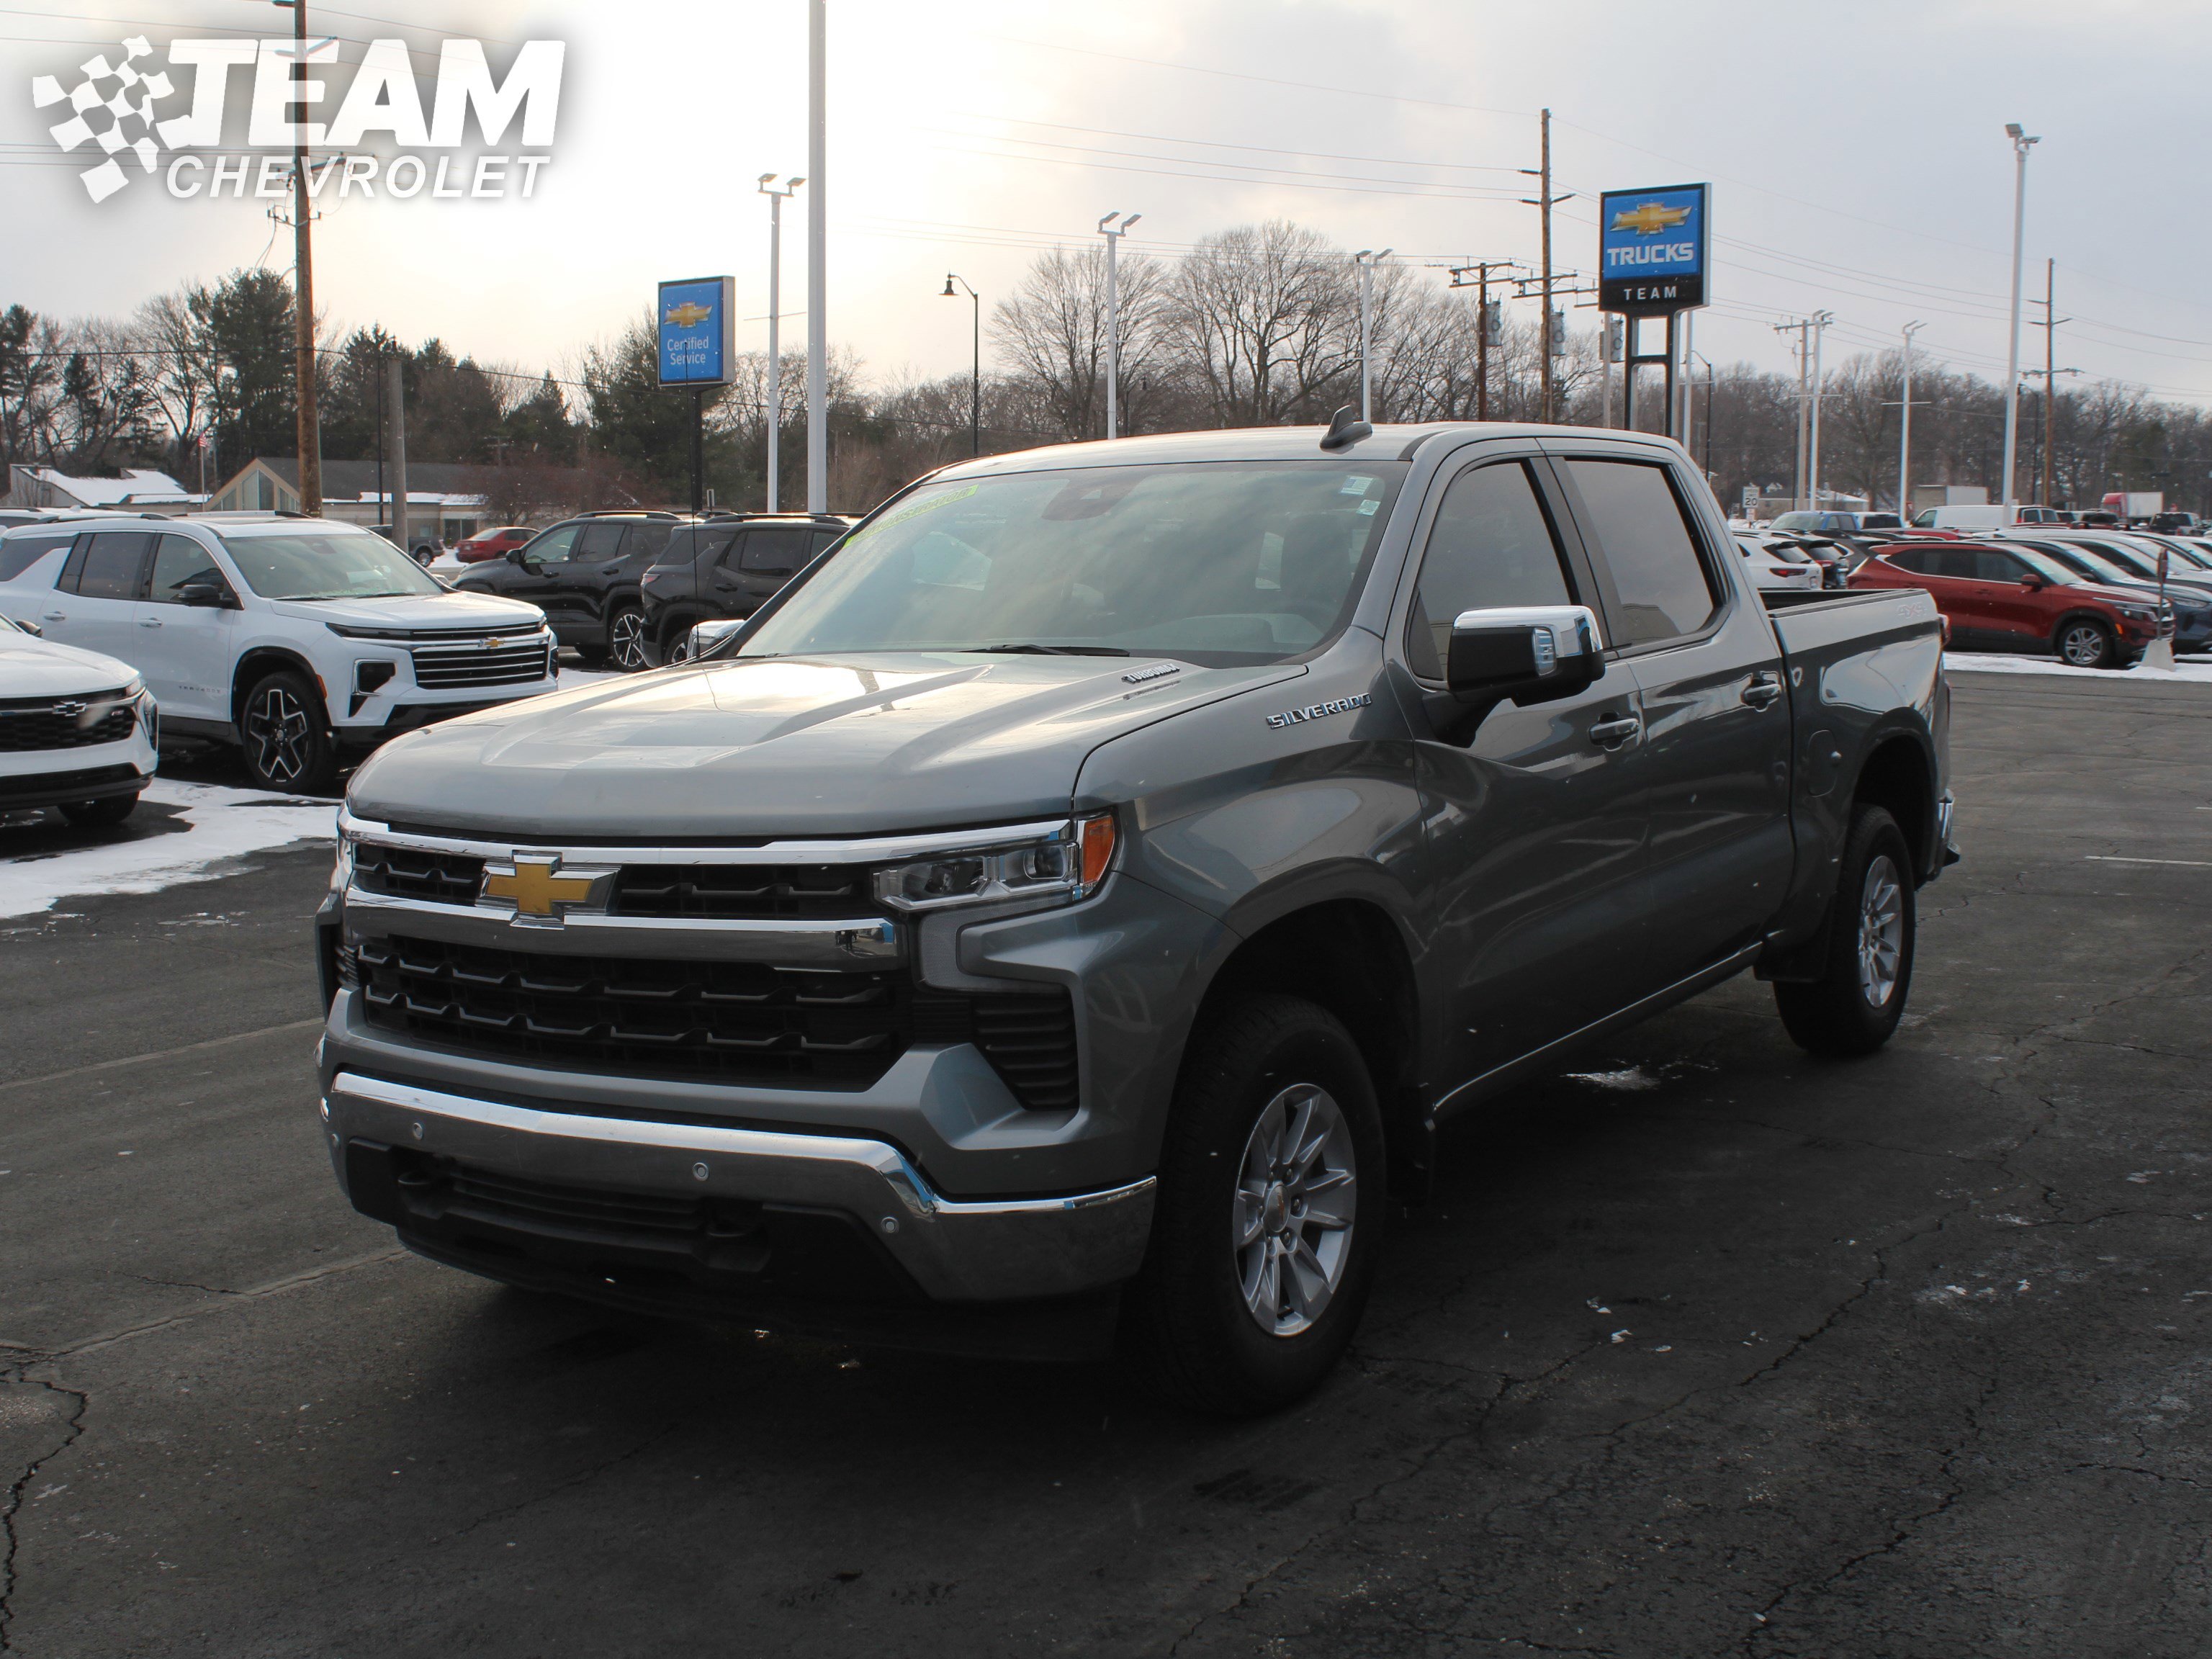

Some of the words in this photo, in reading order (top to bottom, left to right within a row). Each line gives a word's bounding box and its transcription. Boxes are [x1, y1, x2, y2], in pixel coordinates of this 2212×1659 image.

[1606, 242, 1694, 266] TRUCKS
[1624, 285, 1678, 301] TEAM
[667, 335, 709, 351] Certified
[670, 352, 706, 365] Service
[1745, 498, 1758, 506] 20
[1121, 662, 1180, 684] TURBOMAX
[1266, 692, 1372, 729] SILVERADO
